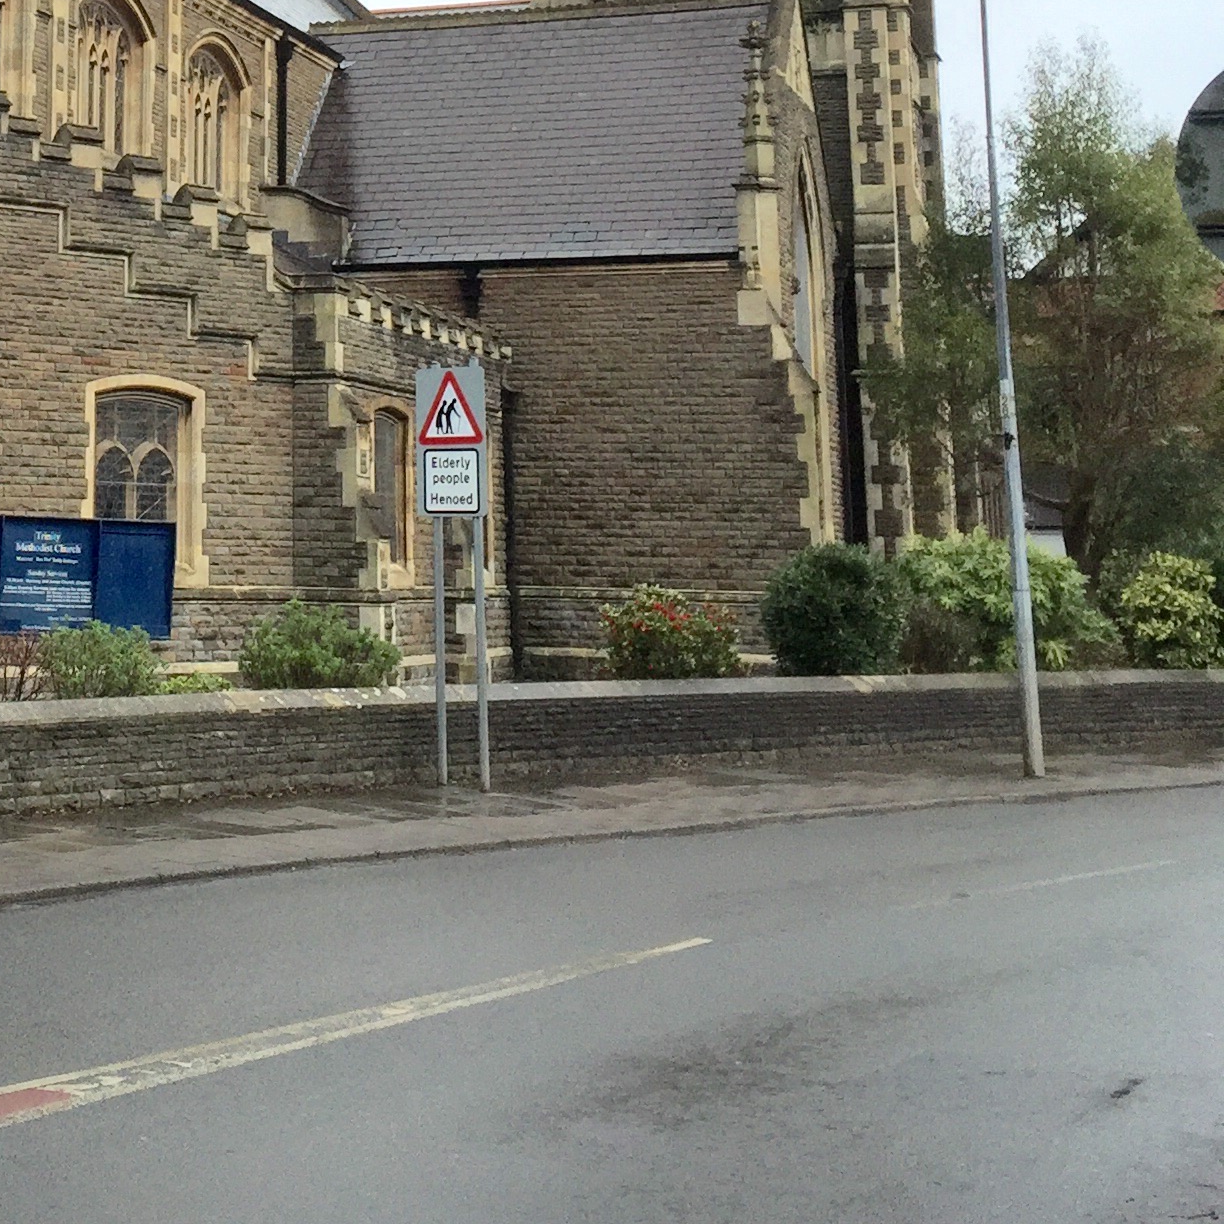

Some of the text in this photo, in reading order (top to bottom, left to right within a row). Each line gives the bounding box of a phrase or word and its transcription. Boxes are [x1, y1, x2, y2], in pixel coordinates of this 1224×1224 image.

[431, 457, 470, 470] Elderly
[433, 472, 470, 485] people
[430, 493, 473, 505] Henoed
[36, 531, 61, 541] Trinity
[16, 543, 81, 553] Methodist Church
